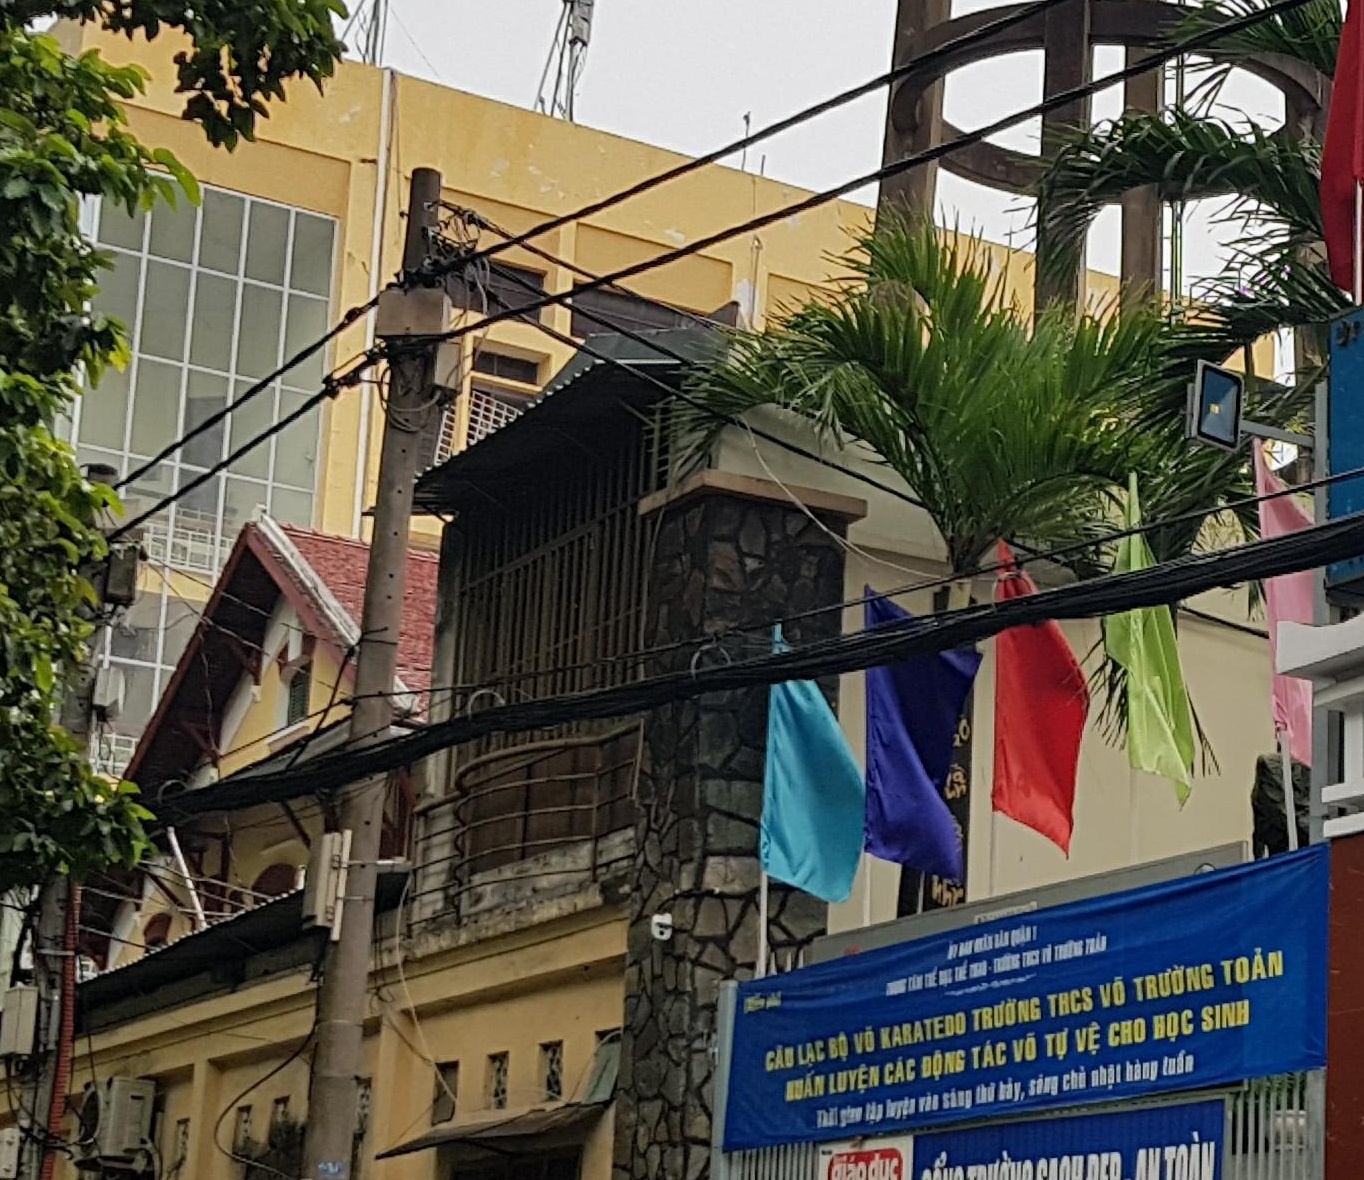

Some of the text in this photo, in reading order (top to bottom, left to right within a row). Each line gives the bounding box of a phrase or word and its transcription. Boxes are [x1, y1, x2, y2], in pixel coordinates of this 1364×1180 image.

[798, 1040, 826, 1068] LẠC
[828, 1031, 850, 1063] BỘ
[880, 1011, 968, 1049] KARATEDO
[1047, 987, 1094, 1018] THCS
[1100, 976, 1126, 1009] VÕ
[1133, 964, 1215, 1002] TRƯỜNG
[1221, 947, 1285, 986] TOẢN
[828, 1063, 881, 1094] LUYỆN
[884, 1056, 916, 1085] CÁC
[971, 1040, 1007, 1070] TÁC
[1012, 1032, 1037, 1063] VÕ
[1107, 1017, 1147, 1047] CHO
[1152, 1009, 1194, 1042] HỌC
[1201, 999, 1251, 1033] SINH
[942, 1087, 974, 1110] sáng
[1028, 1072, 1060, 1096] sáng
[1062, 1065, 1088, 1091] chủ
[1091, 1062, 1122, 1090] nhật
[1126, 1057, 1159, 1083] hàng
[1162, 1049, 1195, 1076] tuần
